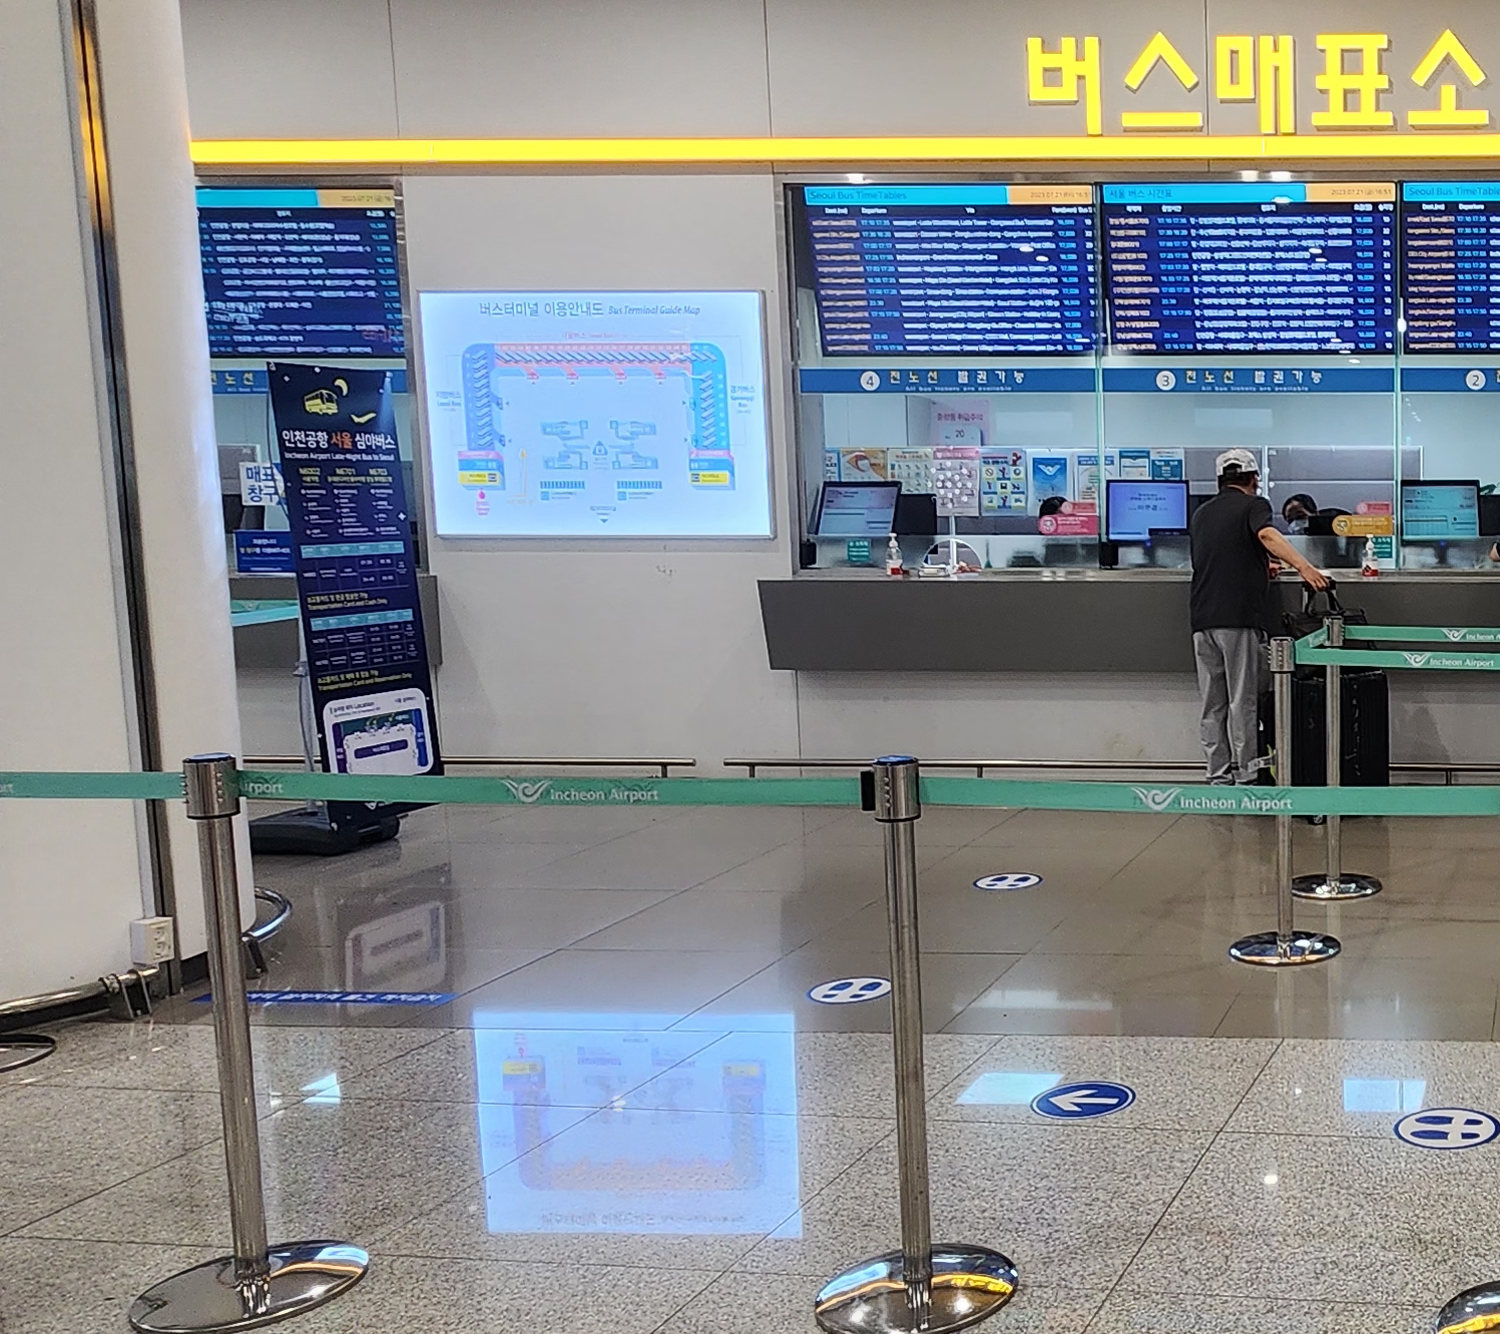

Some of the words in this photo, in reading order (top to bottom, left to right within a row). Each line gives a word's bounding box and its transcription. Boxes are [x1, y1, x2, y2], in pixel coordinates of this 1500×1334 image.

[1027, 29, 1490, 135] 버스매표소
[810, 191, 836, 200] Seoul
[838, 191, 854, 200] Bus
[1109, 189, 1126, 199] 서울
[1128, 189, 1145, 198] 버스
[1148, 189, 1172, 198] 시간표
[1409, 187, 1433, 196] Seoul
[1436, 187, 1453, 196] Bus
[479, 302, 539, 317] 버스터미널
[544, 301, 604, 316] 이용안내도
[608, 305, 623, 315] Bus
[625, 305, 658, 315] Terminal
[660, 305, 681, 315] Guide
[683, 305, 700, 317] Map
[866, 375, 874, 386] 4
[1162, 375, 1170, 386] 3
[1472, 375, 1480, 386] 2
[282, 430, 328, 448] 인천공항
[330, 431, 352, 449] 서울
[355, 432, 396, 450] 심야버스
[284, 451, 309, 459] Incheon
[310, 452, 330, 460] Airport
[1466, 633, 1494, 641] Incheon
[1429, 658, 1463, 666] Incheon
[1464, 659, 1494, 668] Airport
[550, 788, 605, 801] Incheon
[609, 788, 659, 803] Airport
[1180, 796, 1236, 810] Incheon
[1241, 797, 1292, 812] Airport
